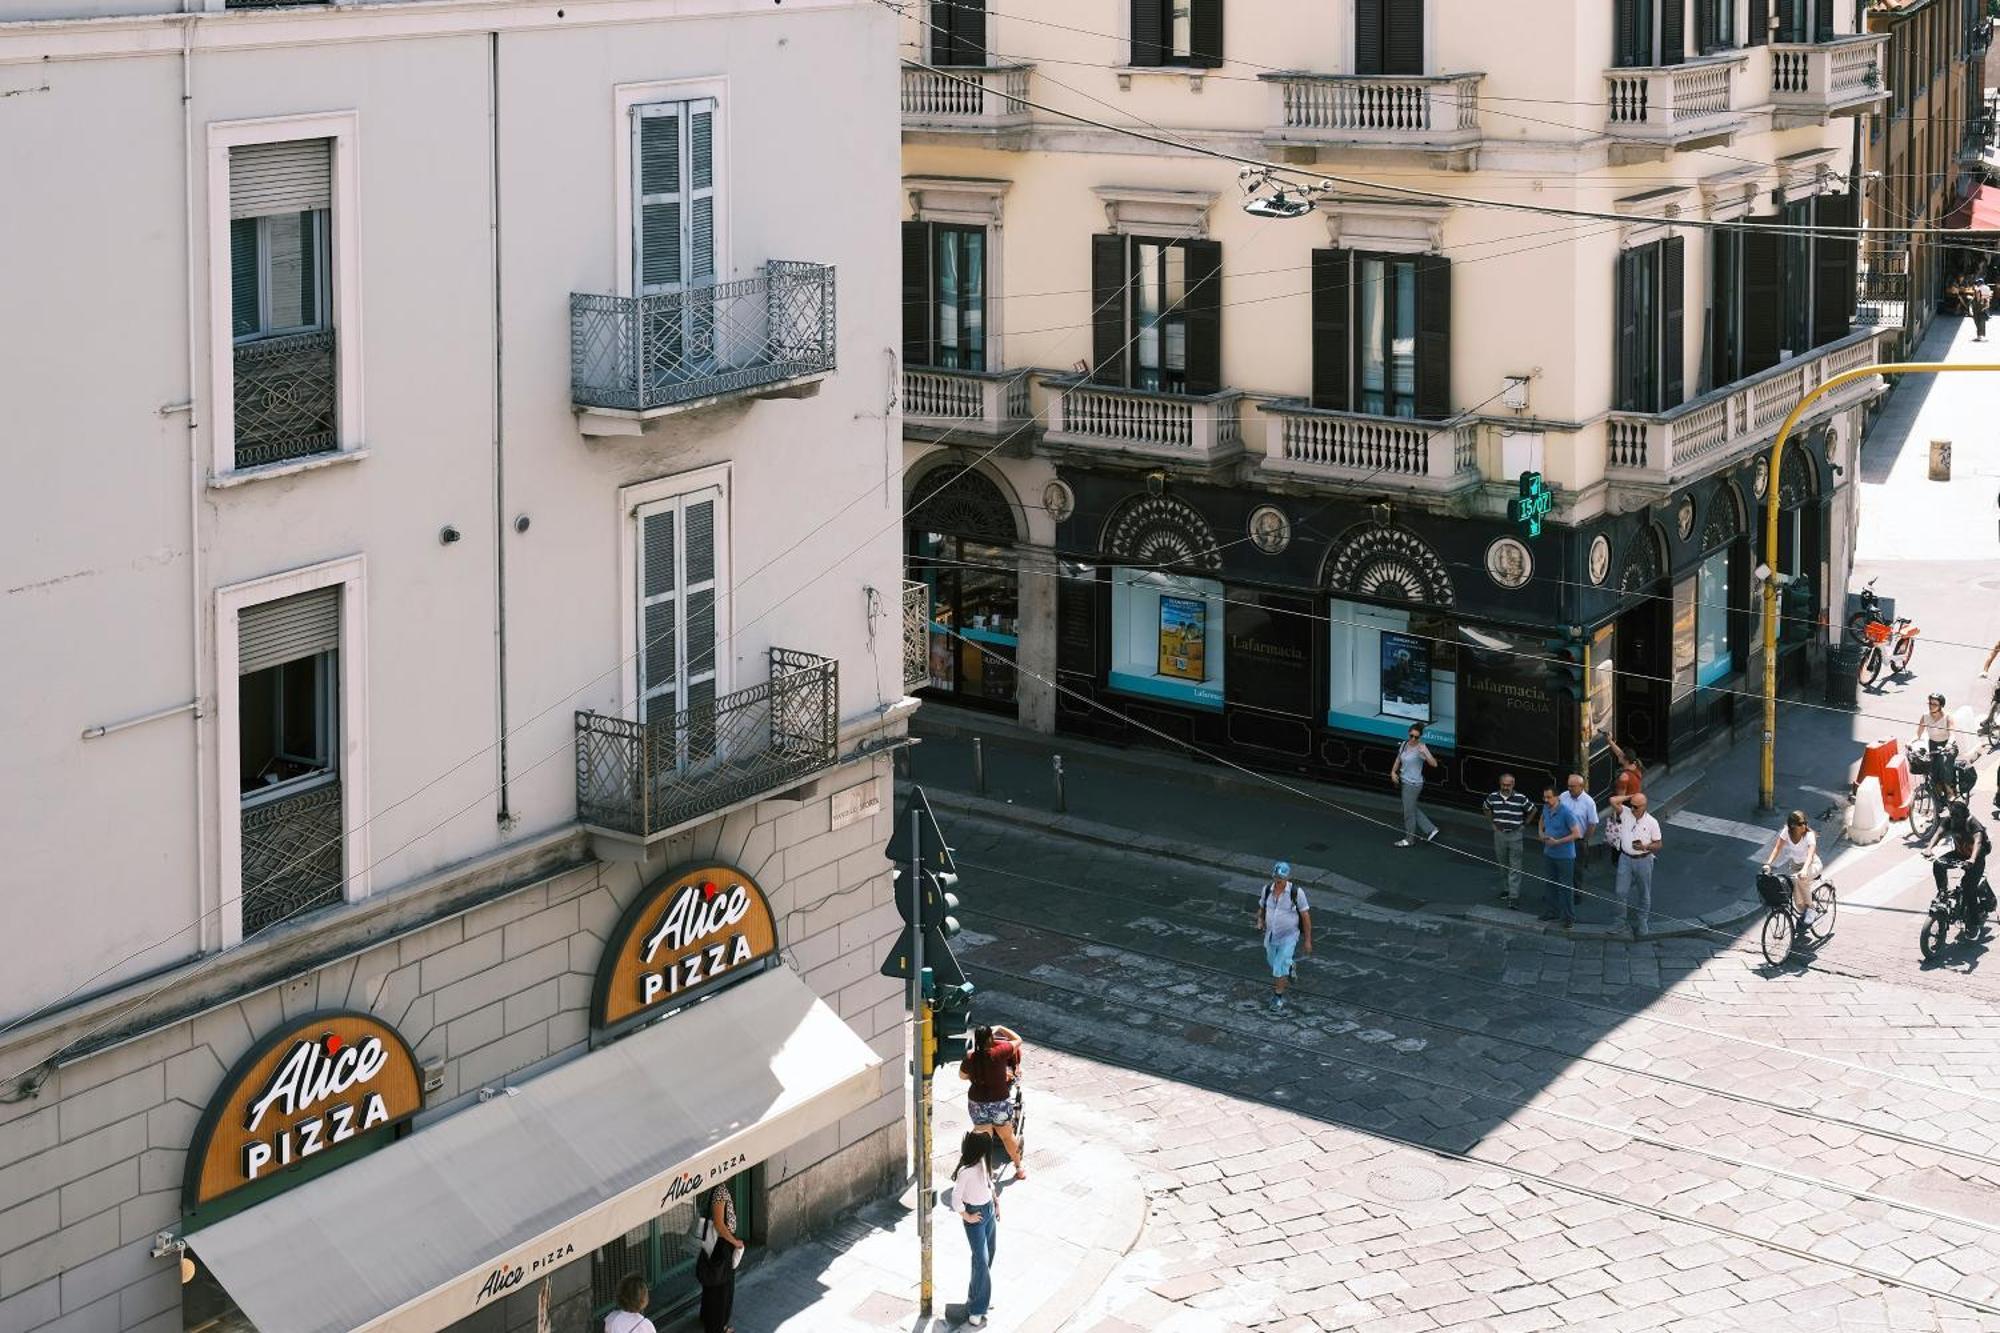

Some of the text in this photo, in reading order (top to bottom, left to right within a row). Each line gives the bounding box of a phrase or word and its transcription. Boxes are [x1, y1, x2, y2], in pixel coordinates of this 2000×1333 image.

[1506, 697, 1550, 713] FOGLIA
[645, 881, 751, 964] Alice
[643, 934, 752, 1005] PIZZA
[247, 1035, 388, 1133] Alice
[246, 1093, 389, 1180] PIZZA
[661, 1153, 746, 1208] Alice PIZZA
[476, 1243, 575, 1305] Alice PIZZA
